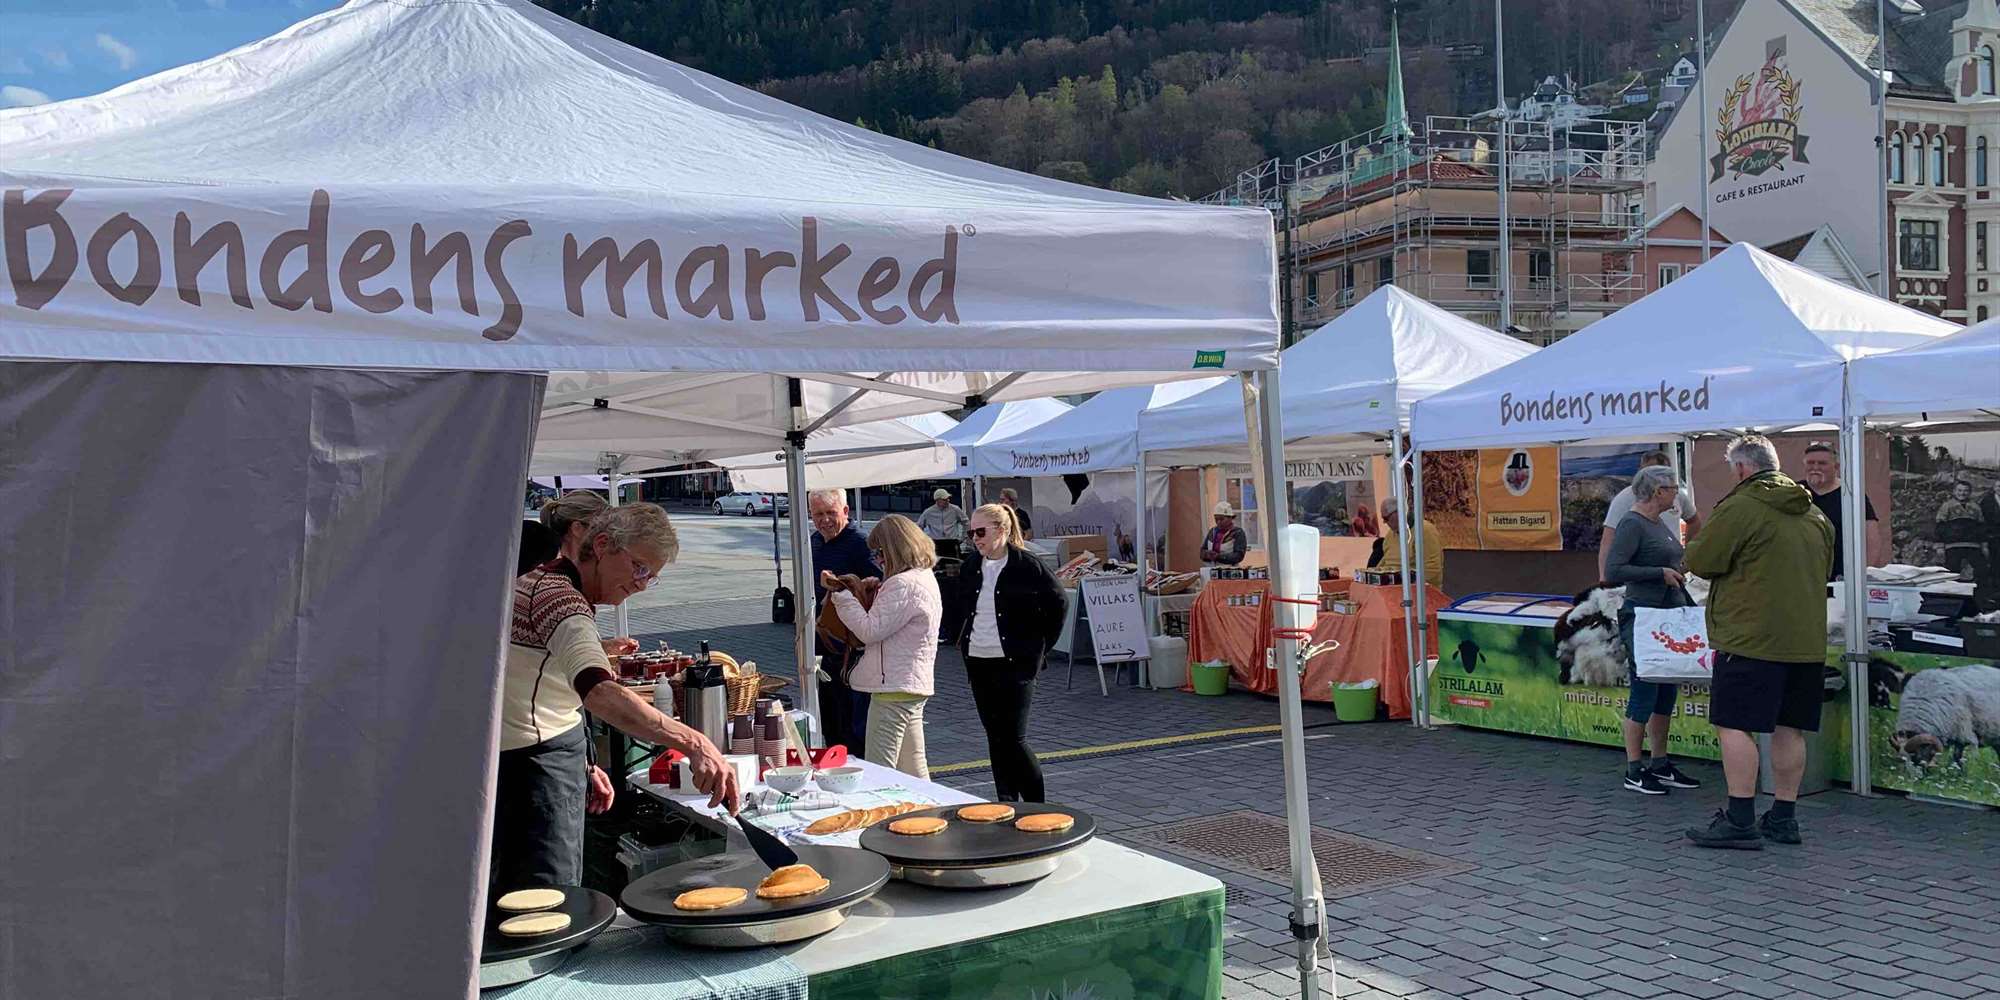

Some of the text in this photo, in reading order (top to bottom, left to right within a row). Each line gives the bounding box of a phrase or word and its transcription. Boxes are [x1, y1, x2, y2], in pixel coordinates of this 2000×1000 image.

[1716, 175, 1805, 203] CAFE & RESTAURANT
[3, 188, 533, 341] Bondens
[1500, 391, 1595, 426] Bondens
[1285, 461, 1366, 477] EIREN LAKS
[1088, 593, 1136, 606] VILLAKS
[1096, 622, 1126, 634] AURE
[1564, 690, 1612, 707] mindre
